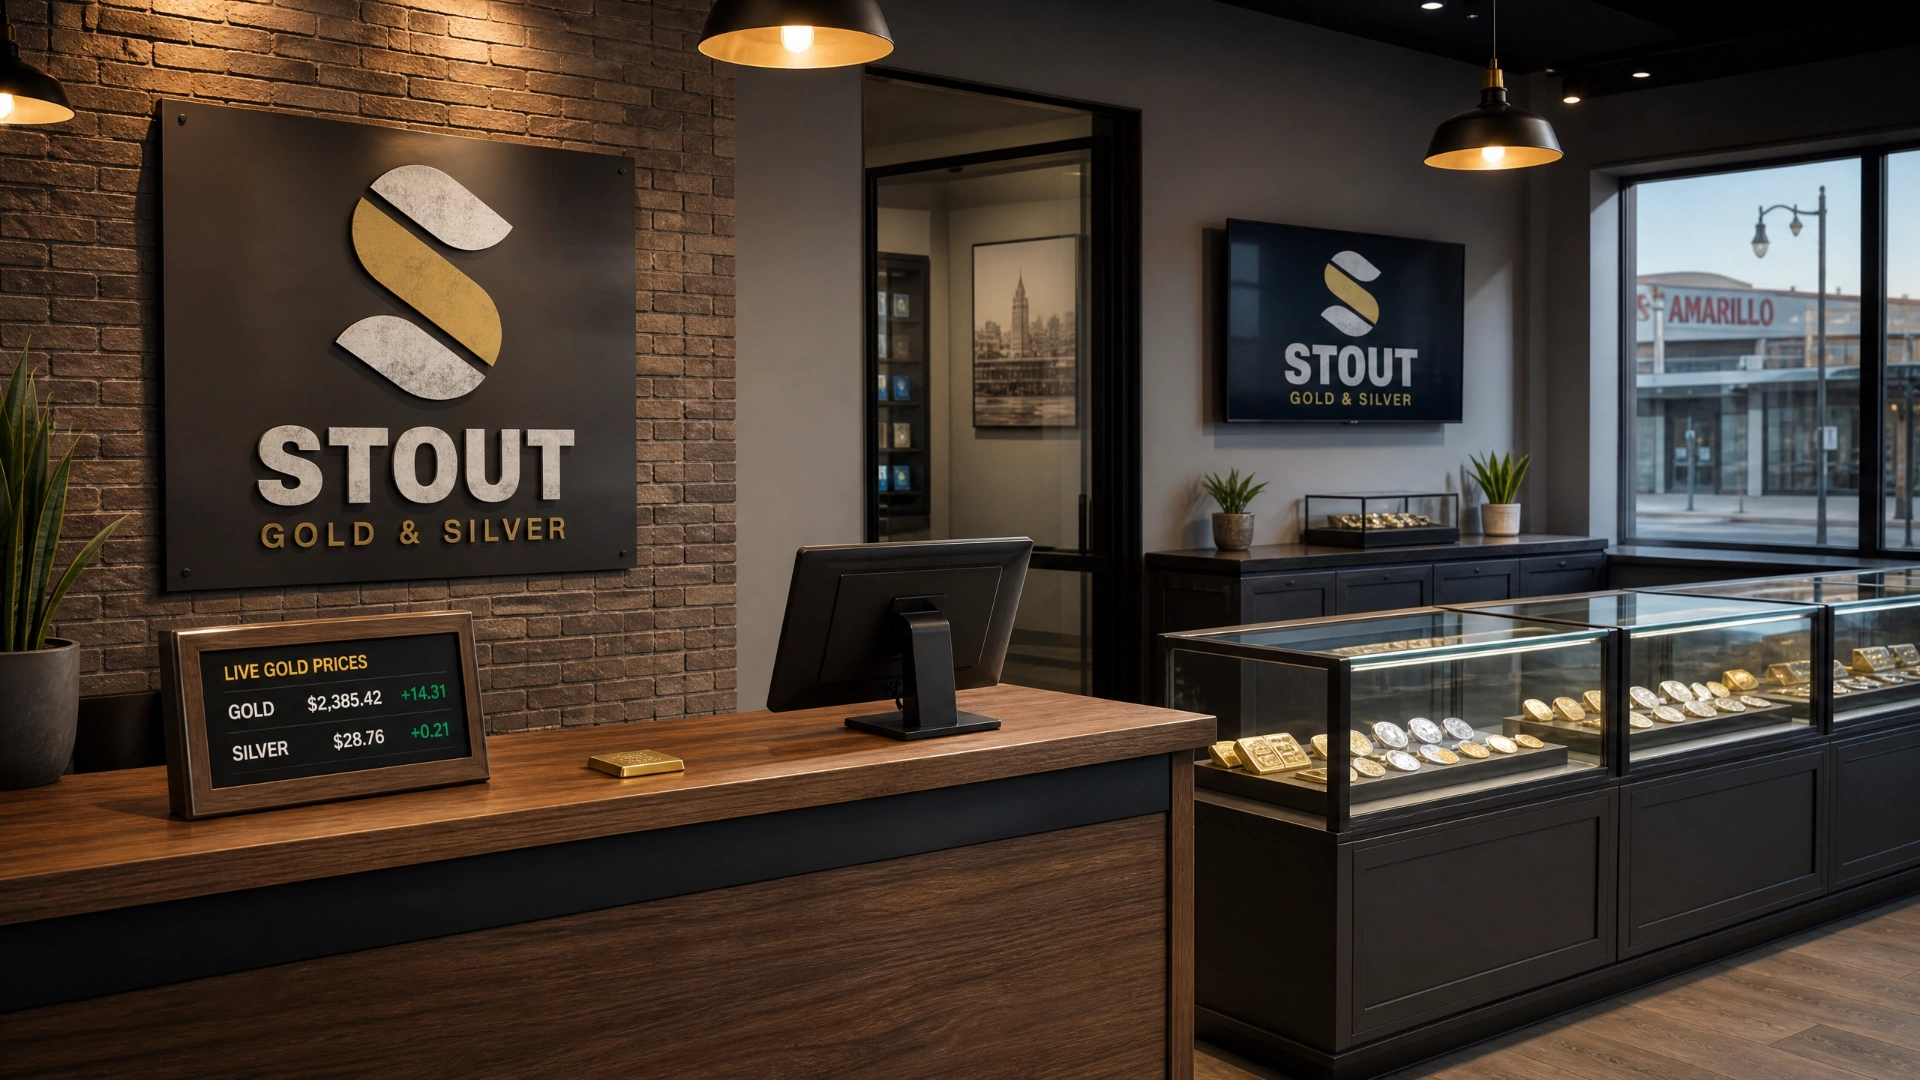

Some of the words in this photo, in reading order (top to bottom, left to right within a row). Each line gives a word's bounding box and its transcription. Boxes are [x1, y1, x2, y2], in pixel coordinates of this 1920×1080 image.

[1668, 294, 1775, 326] AMARILLO
[1284, 342, 1419, 387] STOUT
[1289, 390, 1335, 406] GOLD
[1341, 391, 1352, 406] &
[1358, 392, 1412, 406] SILVER
[257, 424, 575, 507] STOUT
[260, 521, 374, 549] GOLD
[399, 519, 421, 545] &
[443, 516, 566, 544] SILVER
[224, 663, 260, 682] LIVE
[263, 659, 309, 678] GOLD
[312, 653, 368, 674] PRICES
[228, 700, 275, 720] GOLD
[307, 689, 383, 714] $2,385.42
[401, 683, 446, 701] +14.31
[232, 740, 290, 762] SILVER
[333, 728, 385, 752] $28.76
[410, 721, 449, 739] +0.21
